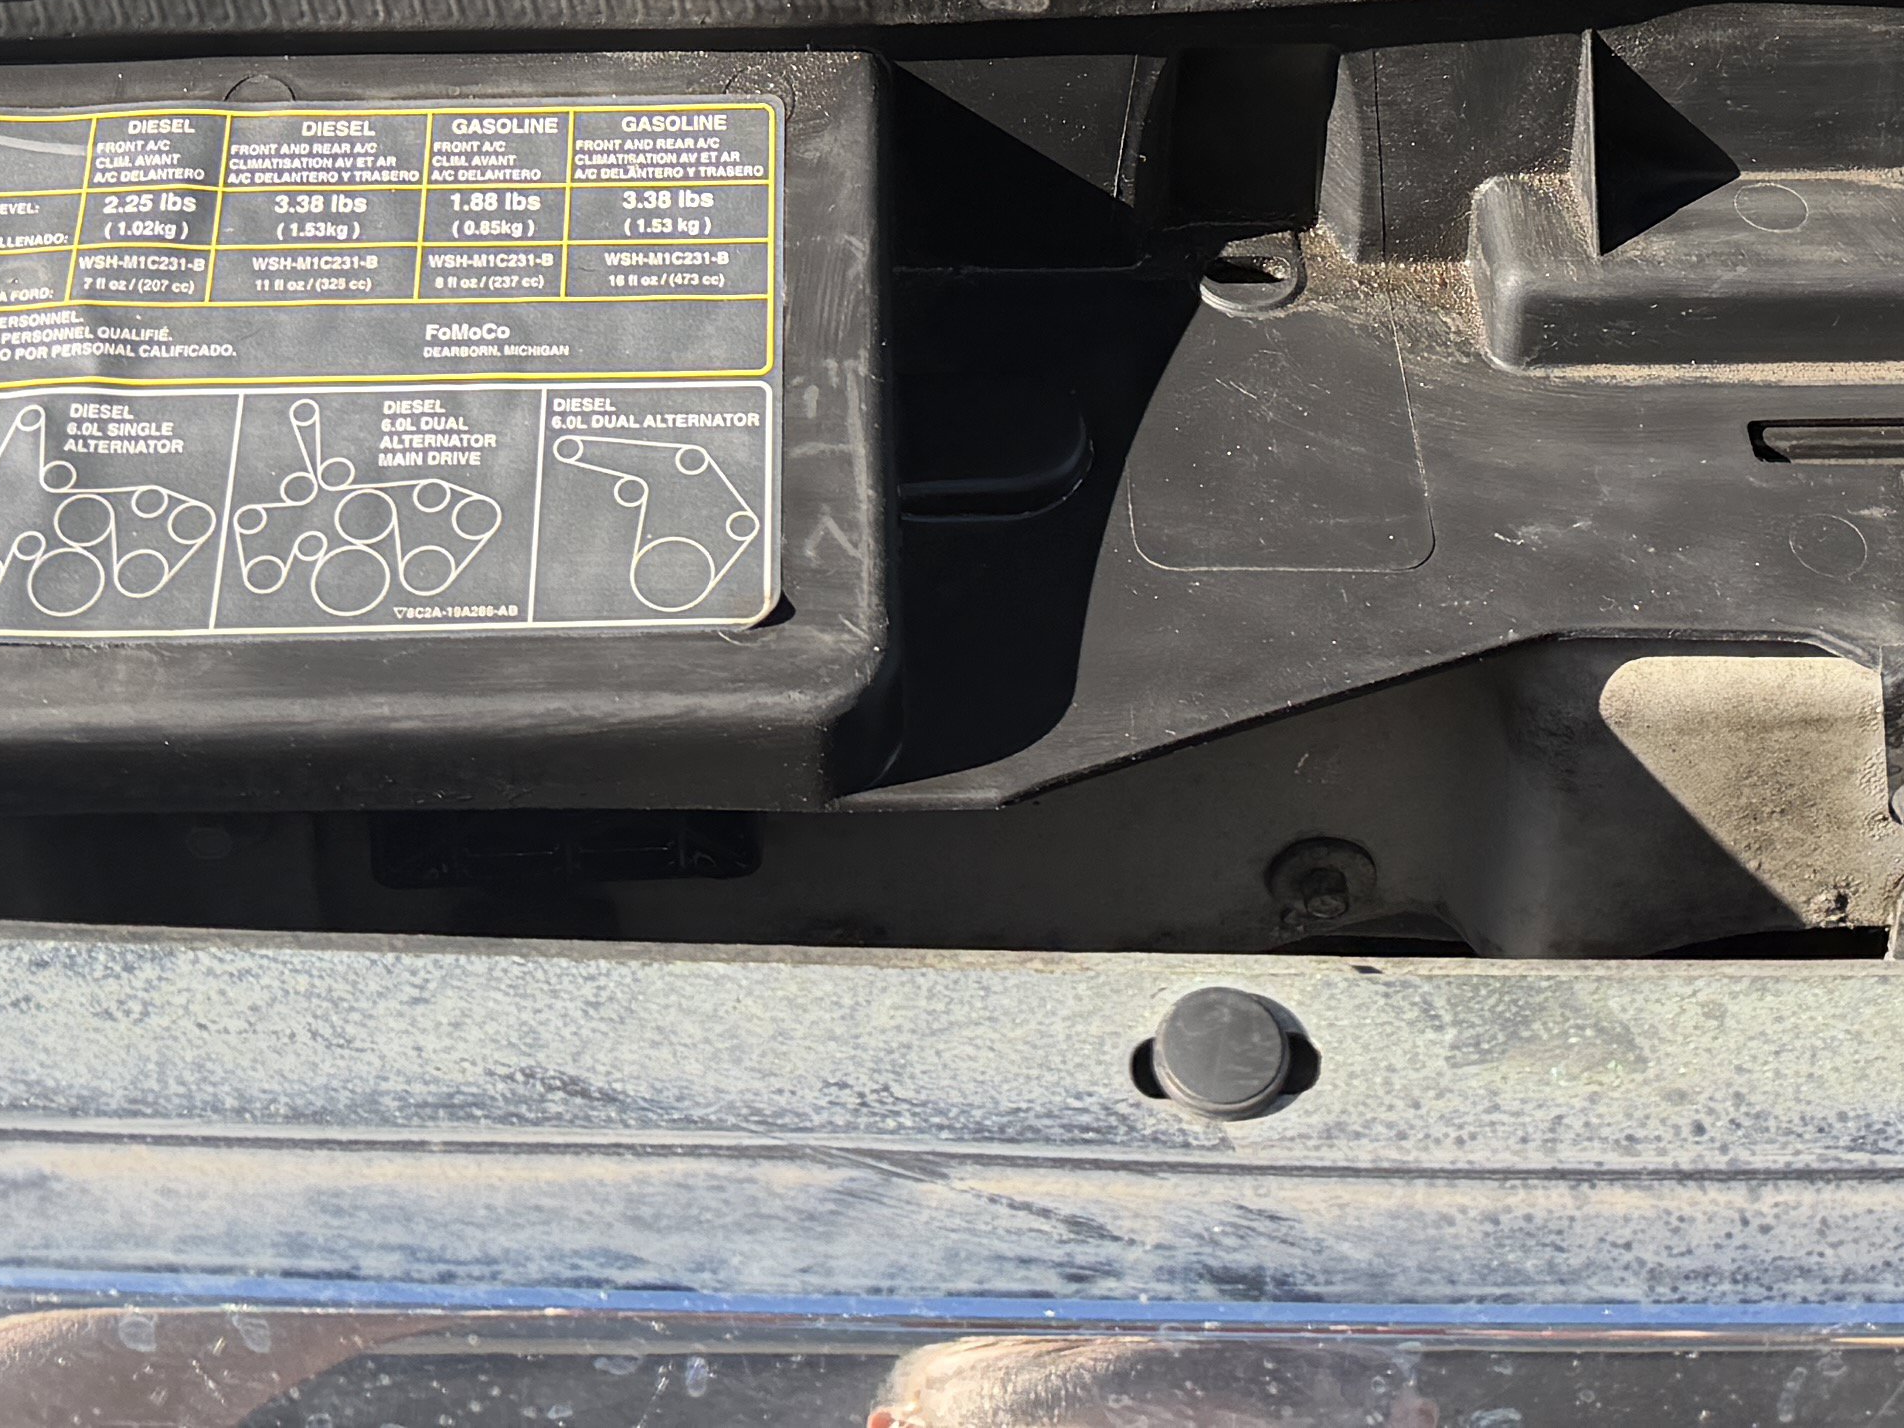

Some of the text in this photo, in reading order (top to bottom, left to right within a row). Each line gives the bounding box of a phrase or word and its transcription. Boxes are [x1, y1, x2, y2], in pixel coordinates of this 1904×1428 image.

[128, 119, 195, 134] DIESEL
[302, 120, 376, 136] DIESEL
[452, 117, 558, 134] GASOLINE
[621, 114, 727, 132] GASOLINE
[96, 139, 170, 155] FRONT A/C
[231, 142, 377, 156] FRONT AND REAR A/C
[434, 140, 506, 152] FRONT A/C
[576, 137, 720, 151] FRONT AND REAR A/C
[93, 166, 205, 183] A/C DELANTERO
[103, 192, 196, 214] 2.25 lbs
[274, 194, 367, 213] 3.38 lbs
[450, 192, 541, 211] 1.88 lbs
[622, 189, 714, 209] 3.38 lbs
[79, 255, 205, 272] WSH-M1C231-B
[252, 255, 378, 271] WSH-M1C231-B
[428, 253, 553, 268] WSH-M1C231-B
[604, 251, 729, 266] WSH-M1C231-B
[0, 325, 94, 345] PERSONNEL
[425, 323, 510, 341] FoMoCo
[14, 346, 48, 360] POR
[49, 340, 135, 360] PERSONAL
[504, 345, 569, 356] MICHIGAN
[70, 403, 134, 419] DIESEL
[383, 399, 446, 414] DIESEL
[553, 398, 616, 412] DIESEL
[381, 416, 469, 432] 6.0L DUAL
[551, 412, 760, 429] 6.0L DUAL ALTERNATOR
[67, 422, 174, 436] 6.0L SINGLE
[63, 438, 184, 454] ALTERNATOR
[379, 434, 496, 449] ALTERNATOR
[378, 451, 481, 466] MAIN DRIVE
